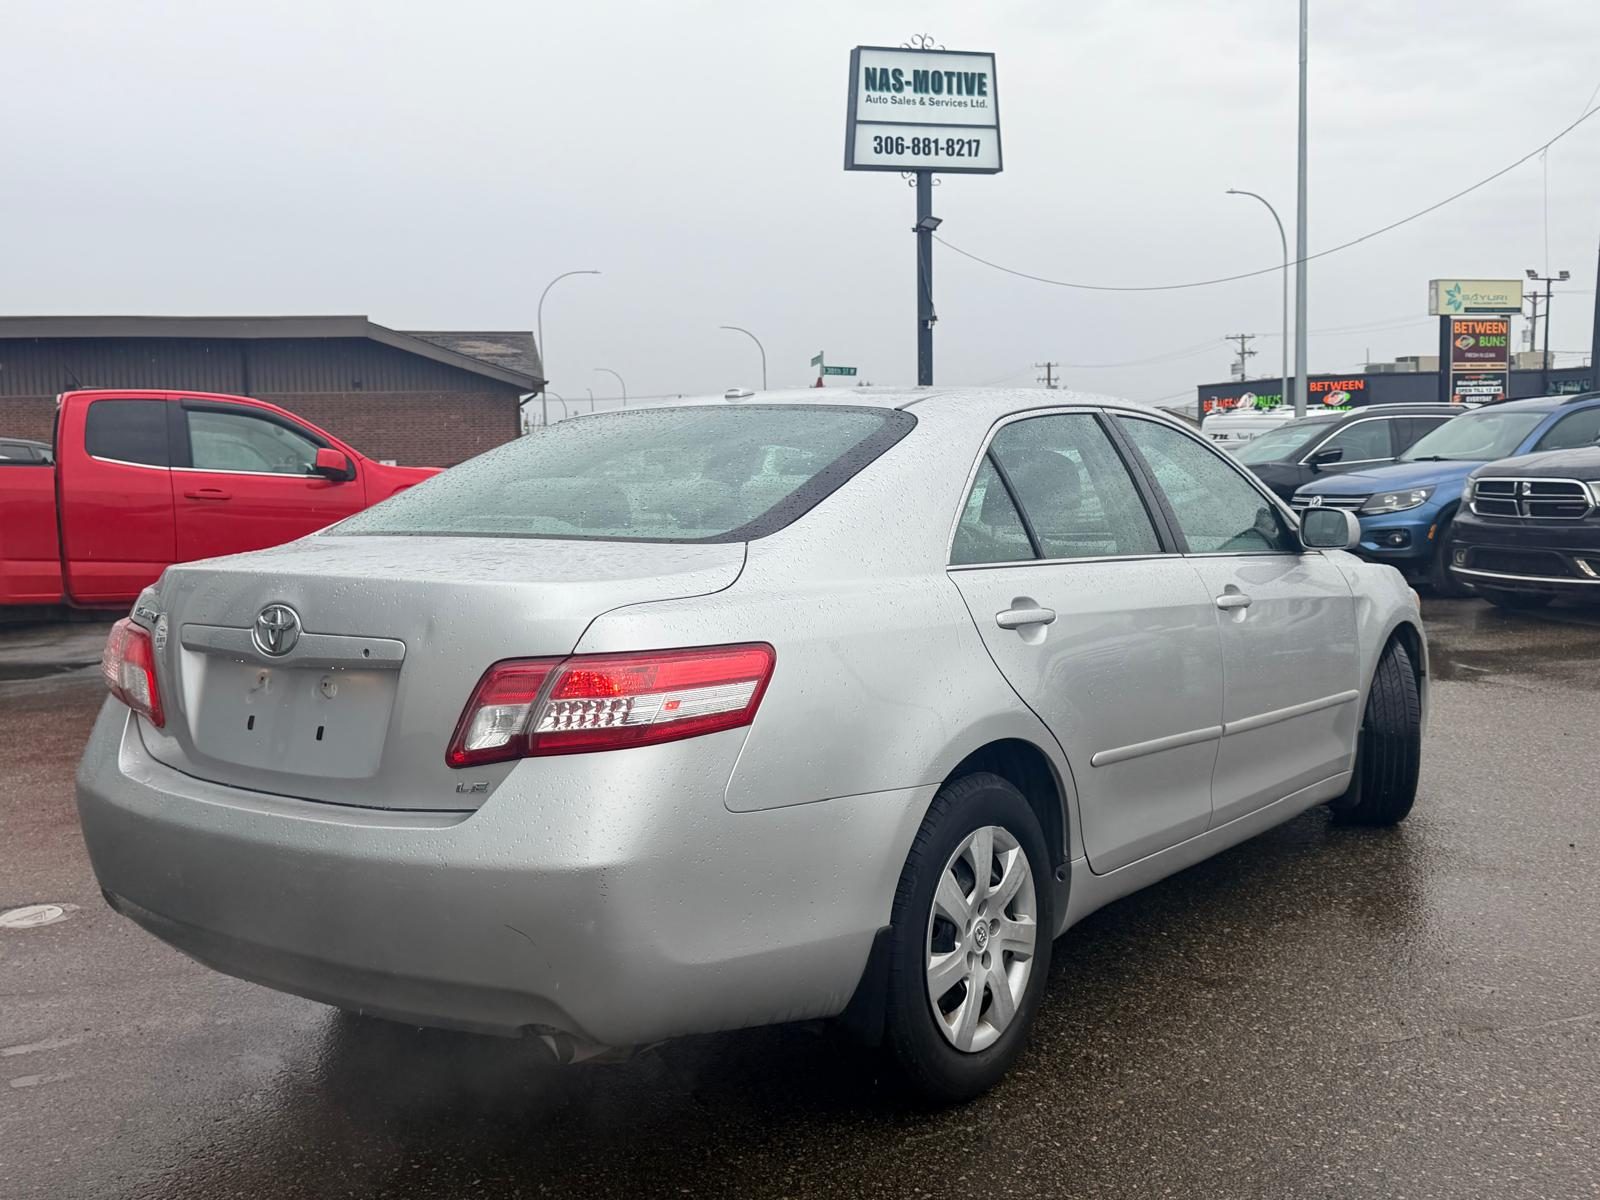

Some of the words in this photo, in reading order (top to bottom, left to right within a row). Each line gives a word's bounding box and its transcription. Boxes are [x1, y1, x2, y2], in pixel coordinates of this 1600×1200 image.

[865, 67, 987, 97] NAS-MOTIVE
[865, 94, 888, 105] Auto
[891, 96, 917, 106] Sales
[918, 97, 926, 106] &
[928, 97, 968, 108] Services
[970, 98, 988, 108] Ltd.
[873, 135, 981, 157] 306-881-8217
[1454, 321, 1507, 334] BETWEEN
[1479, 335, 1506, 347] BUNS
[1309, 379, 1365, 392] BETWEEN
